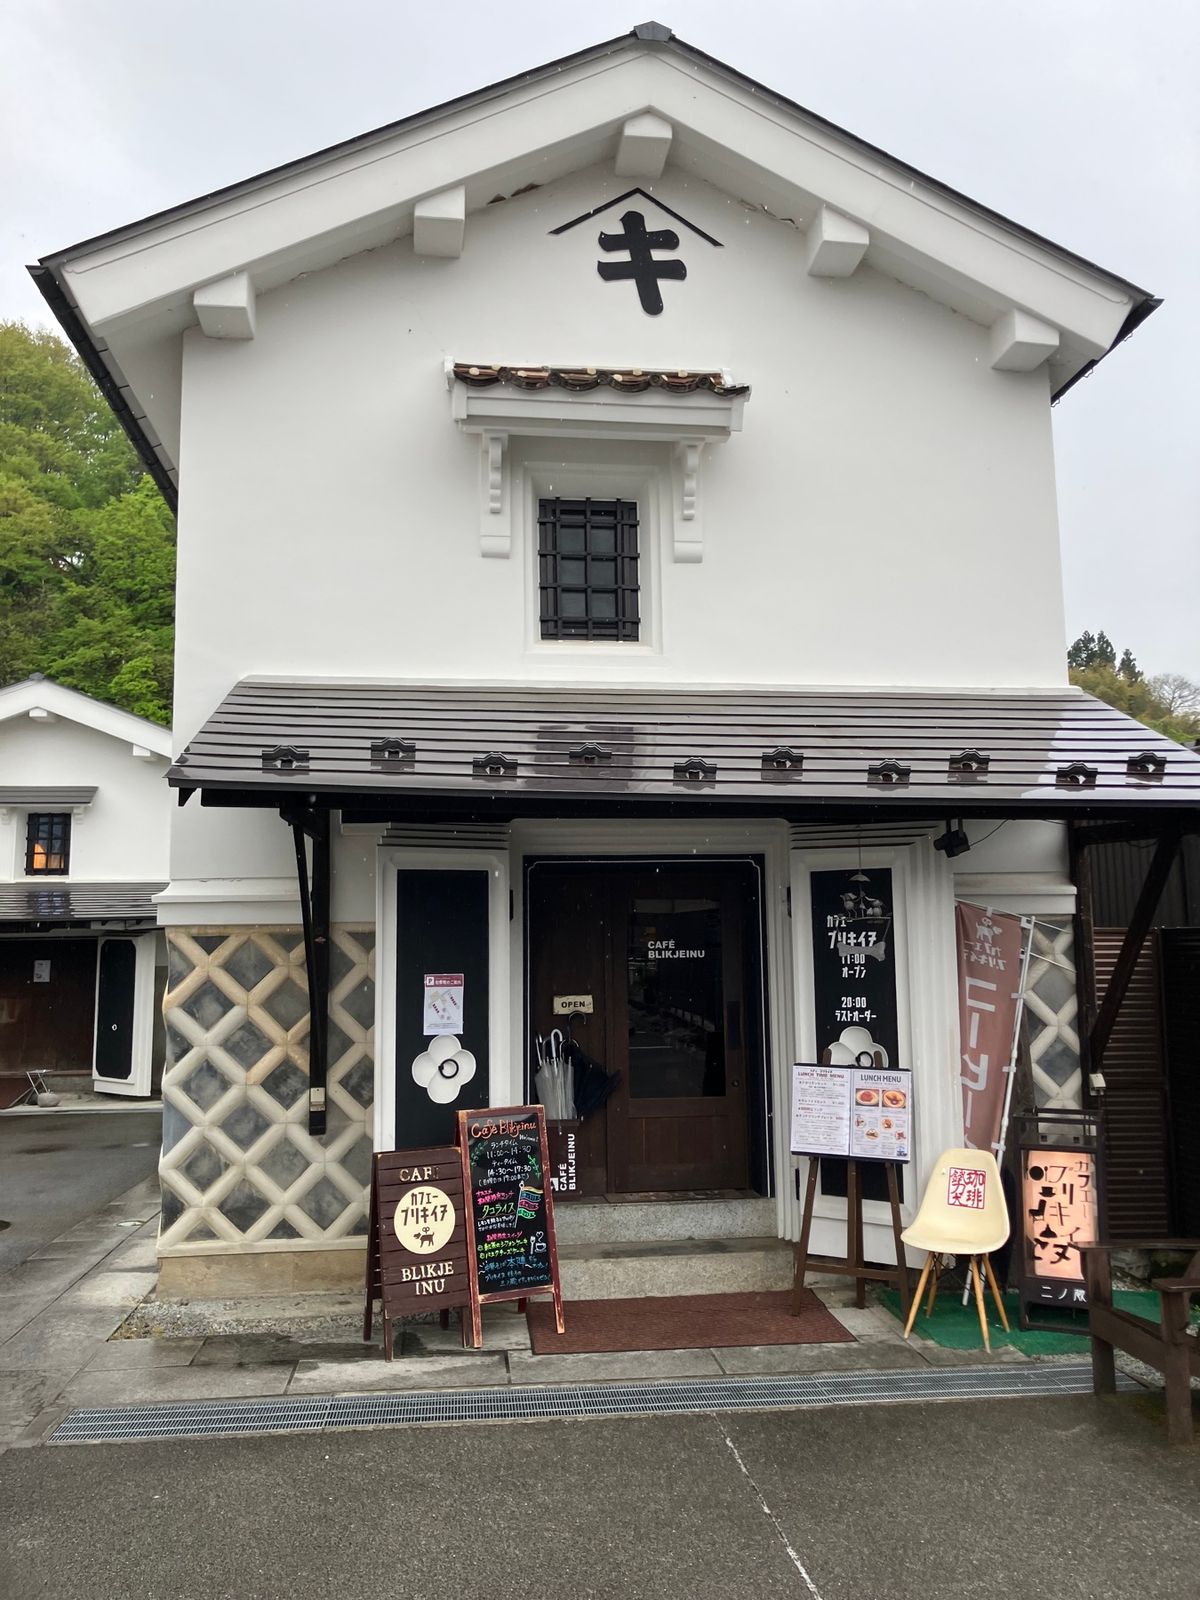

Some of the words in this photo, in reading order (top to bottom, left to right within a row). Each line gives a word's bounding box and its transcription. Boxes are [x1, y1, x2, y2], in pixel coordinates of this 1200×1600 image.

[647, 939, 676, 949] CAFÉ
[827, 931, 877, 949] ブリキイヌ
[647, 950, 705, 959] BLIKJEINU
[841, 953, 866, 965] 11:00
[842, 966, 867, 979] オープン
[561, 1000, 586, 1009] OPEN
[841, 996, 867, 1008] 20:00
[834, 1009, 877, 1022] ラストオーダー
[860, 1073, 882, 1082] LUNCH
[882, 1075, 902, 1083] MENU
[567, 1133, 577, 1190] BLIKJEINU
[557, 1163, 567, 1191] CAFÉ
[410, 1191, 439, 1206] カフェー
[400, 1204, 448, 1226] ブリキイヌ
[482, 1202, 516, 1219] タコライス
[401, 1261, 454, 1282] BLIKJE
[415, 1279, 446, 1296] INU
